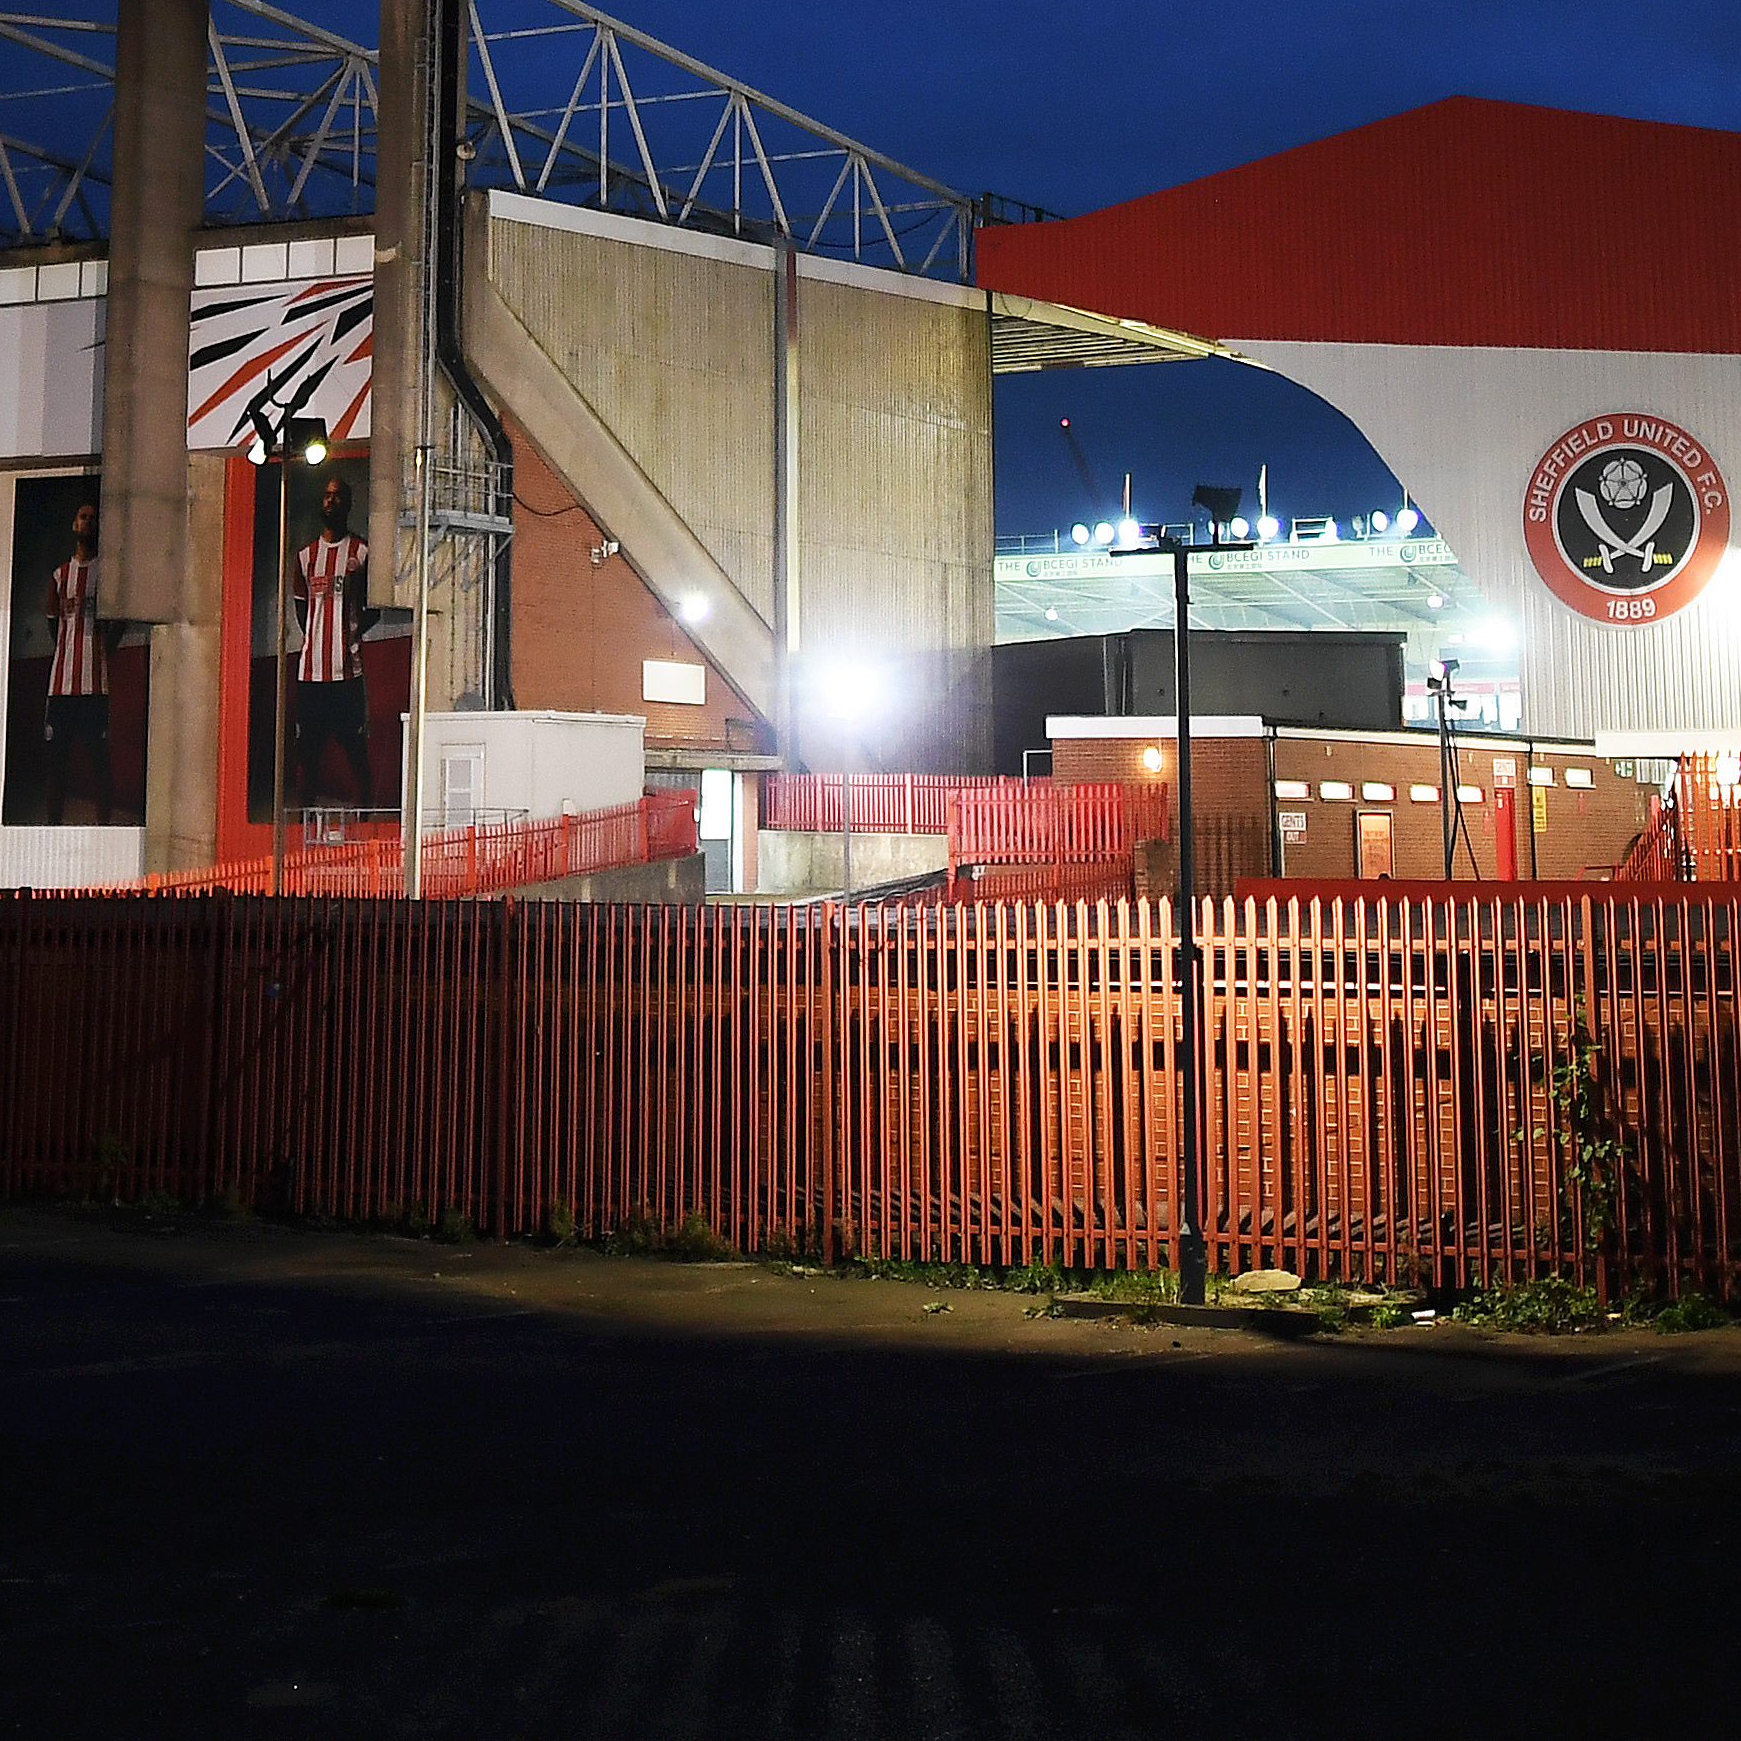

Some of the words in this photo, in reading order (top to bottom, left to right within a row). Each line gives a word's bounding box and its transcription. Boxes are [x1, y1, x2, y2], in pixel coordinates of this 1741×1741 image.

[1528, 421, 1614, 523] SHEFFIELD
[1623, 419, 1702, 468] UNITED
[1697, 471, 1723, 515] F.C.
[1226, 551, 1263, 563] BCEGI
[1267, 549, 1310, 561] STAND
[1369, 546, 1394, 557] THE
[998, 561, 1021, 572] THE
[1043, 559, 1078, 570] BCEGI
[1082, 557, 1123, 569] STAND
[1606, 598, 1656, 620] 1889
